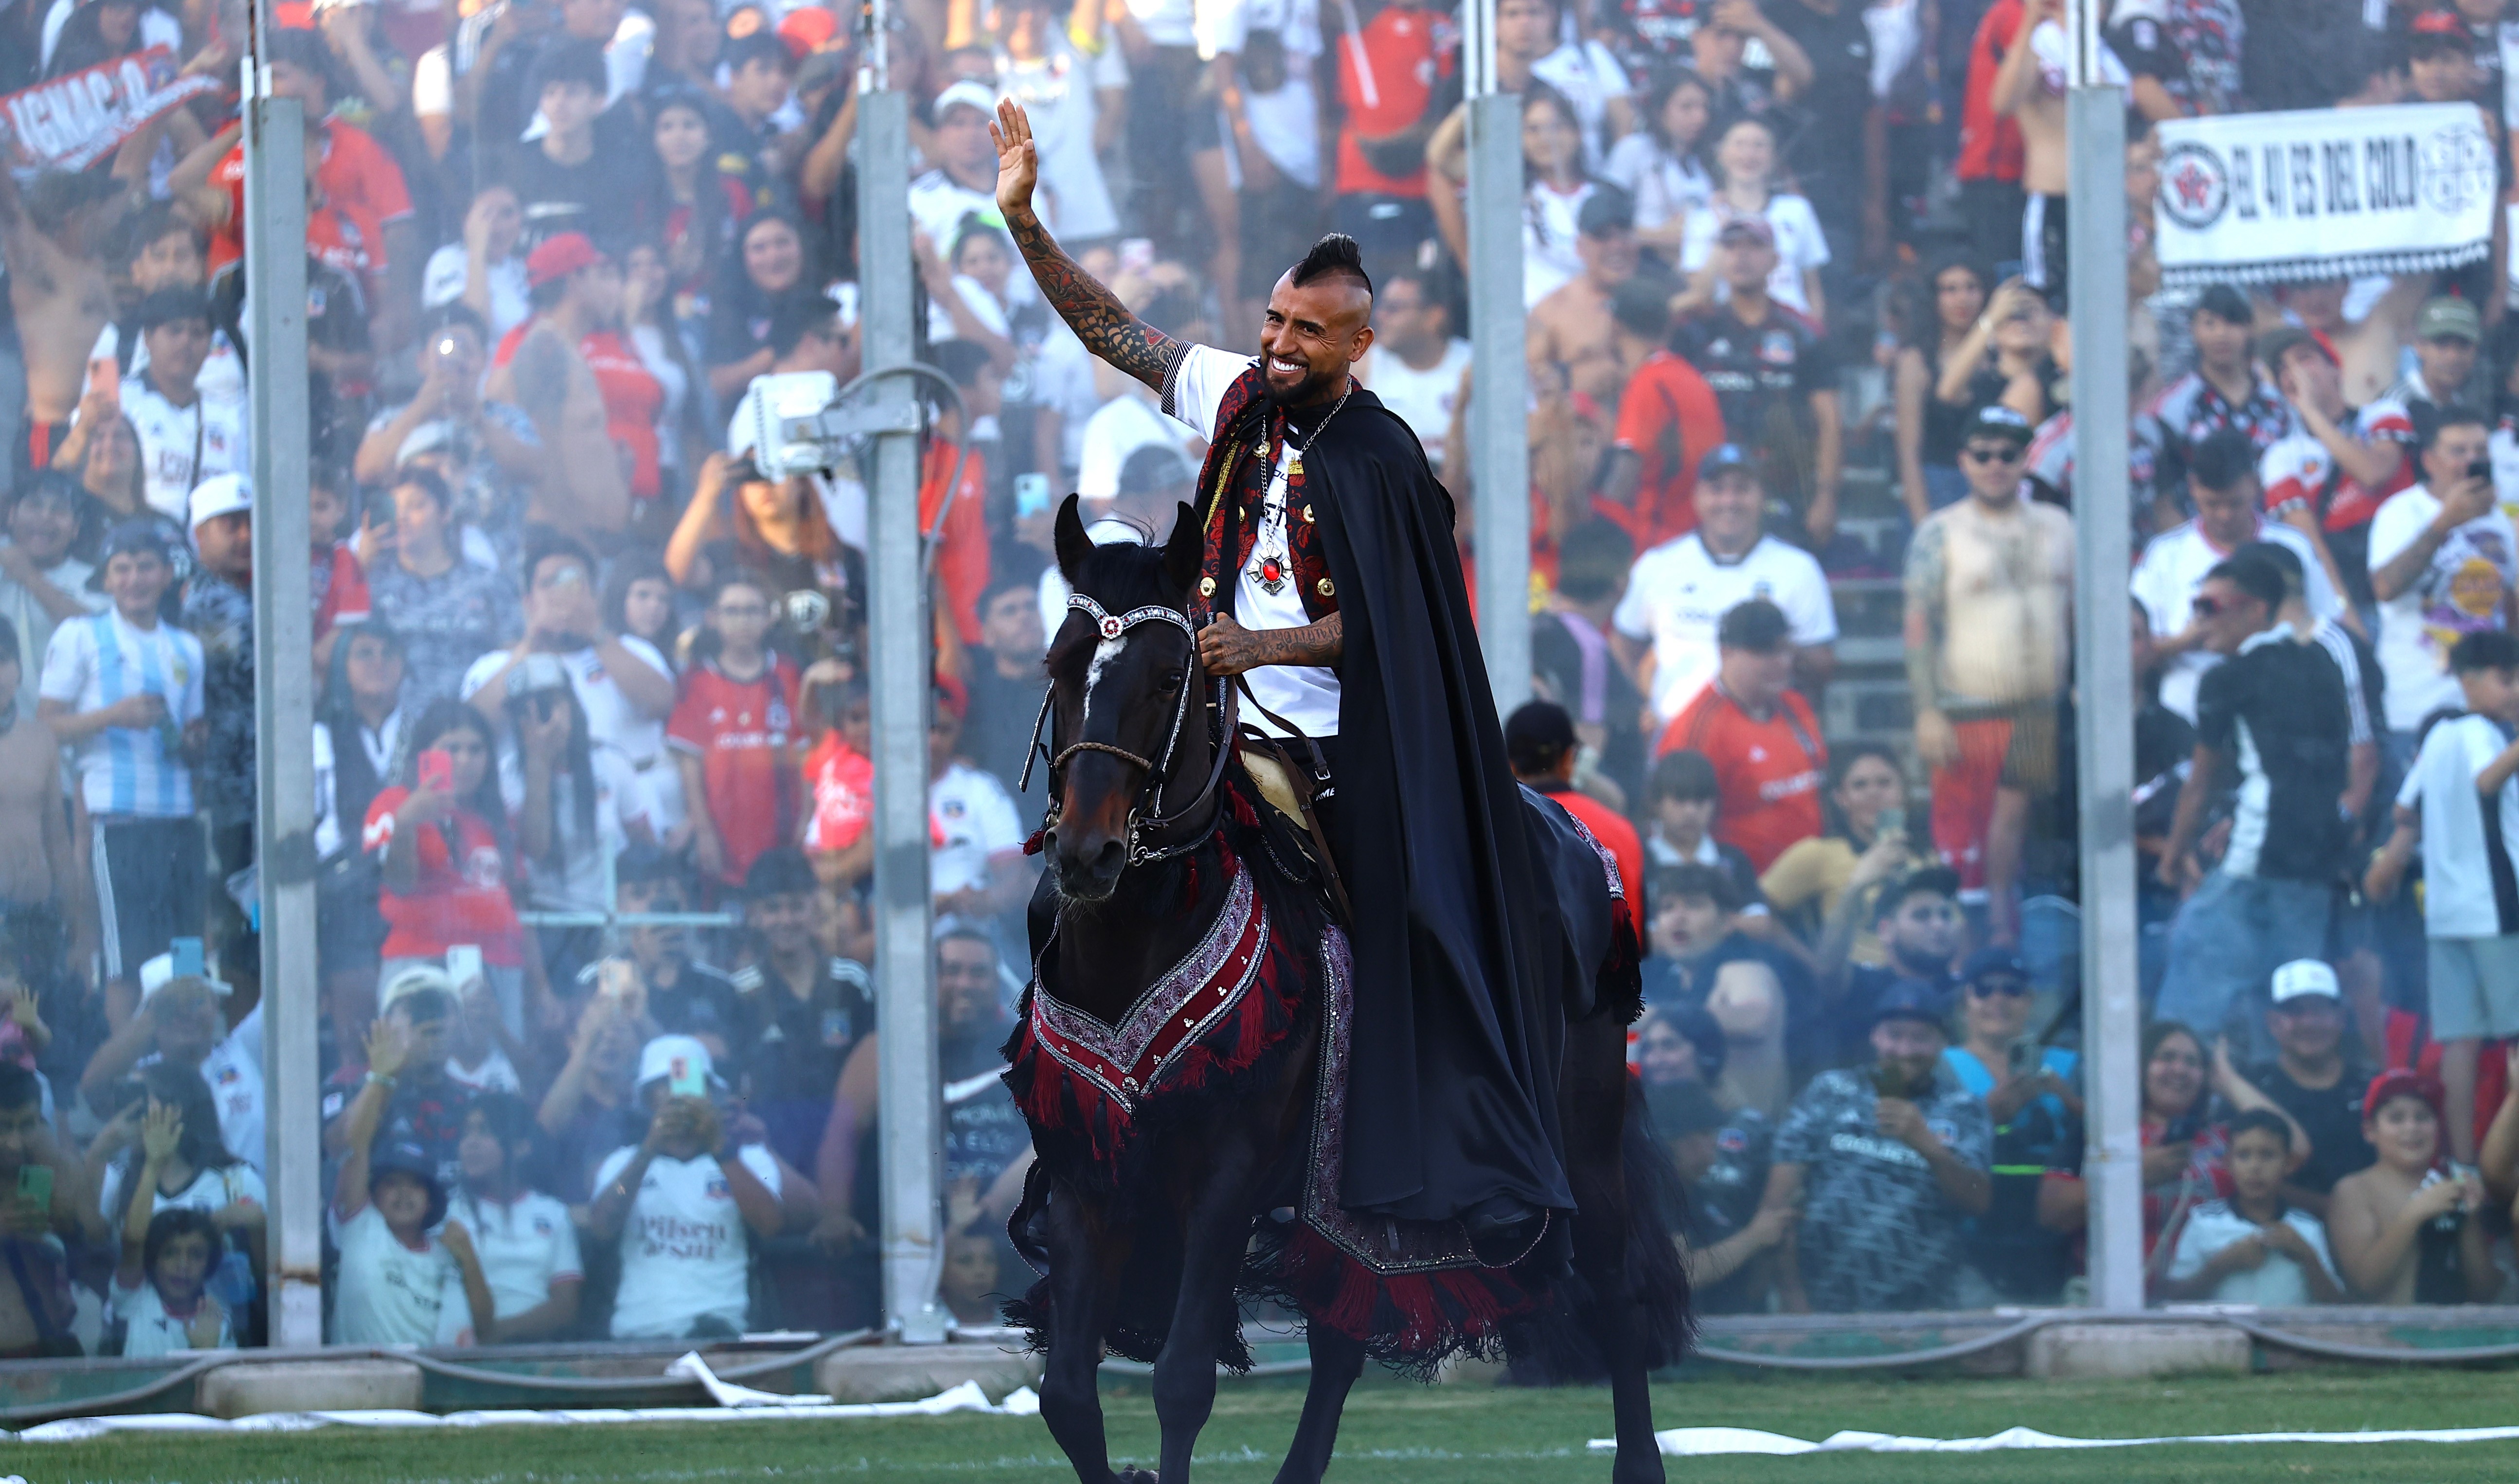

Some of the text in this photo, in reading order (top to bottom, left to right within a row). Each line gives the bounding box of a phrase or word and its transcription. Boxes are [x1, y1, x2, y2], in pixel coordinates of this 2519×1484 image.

[7, 59, 147, 158] IGNACO
[2232, 145, 2258, 218] EL
[2290, 143, 2316, 214] ES
[2322, 141, 2359, 213] DEL
